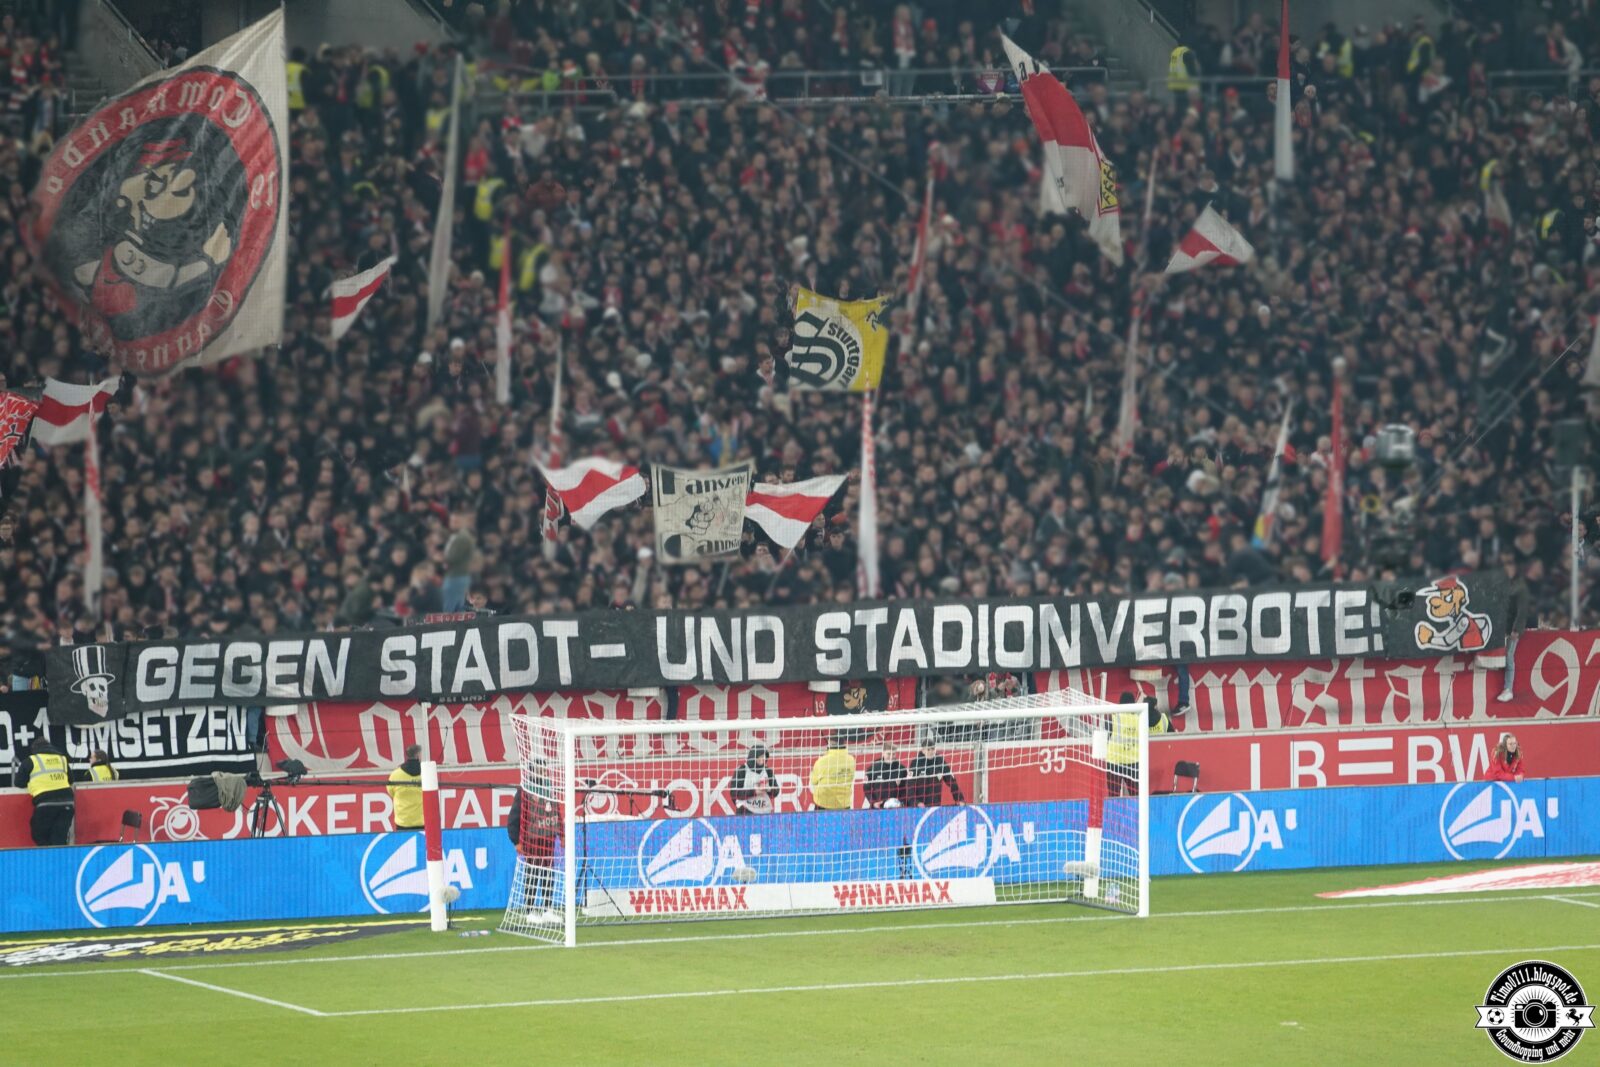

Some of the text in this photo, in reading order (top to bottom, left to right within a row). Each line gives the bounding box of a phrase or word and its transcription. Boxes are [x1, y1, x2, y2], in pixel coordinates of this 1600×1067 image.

[136, 638, 351, 702] GEGEN
[656, 614, 785, 682] UND
[815, 590, 1385, 676] STADIONVERBOTE!
[65, 704, 249, 760] UMSETZEN
[1039, 747, 1066, 774] 35
[628, 886, 750, 914] WINAMAX
[832, 880, 953, 907] WINAMAX
